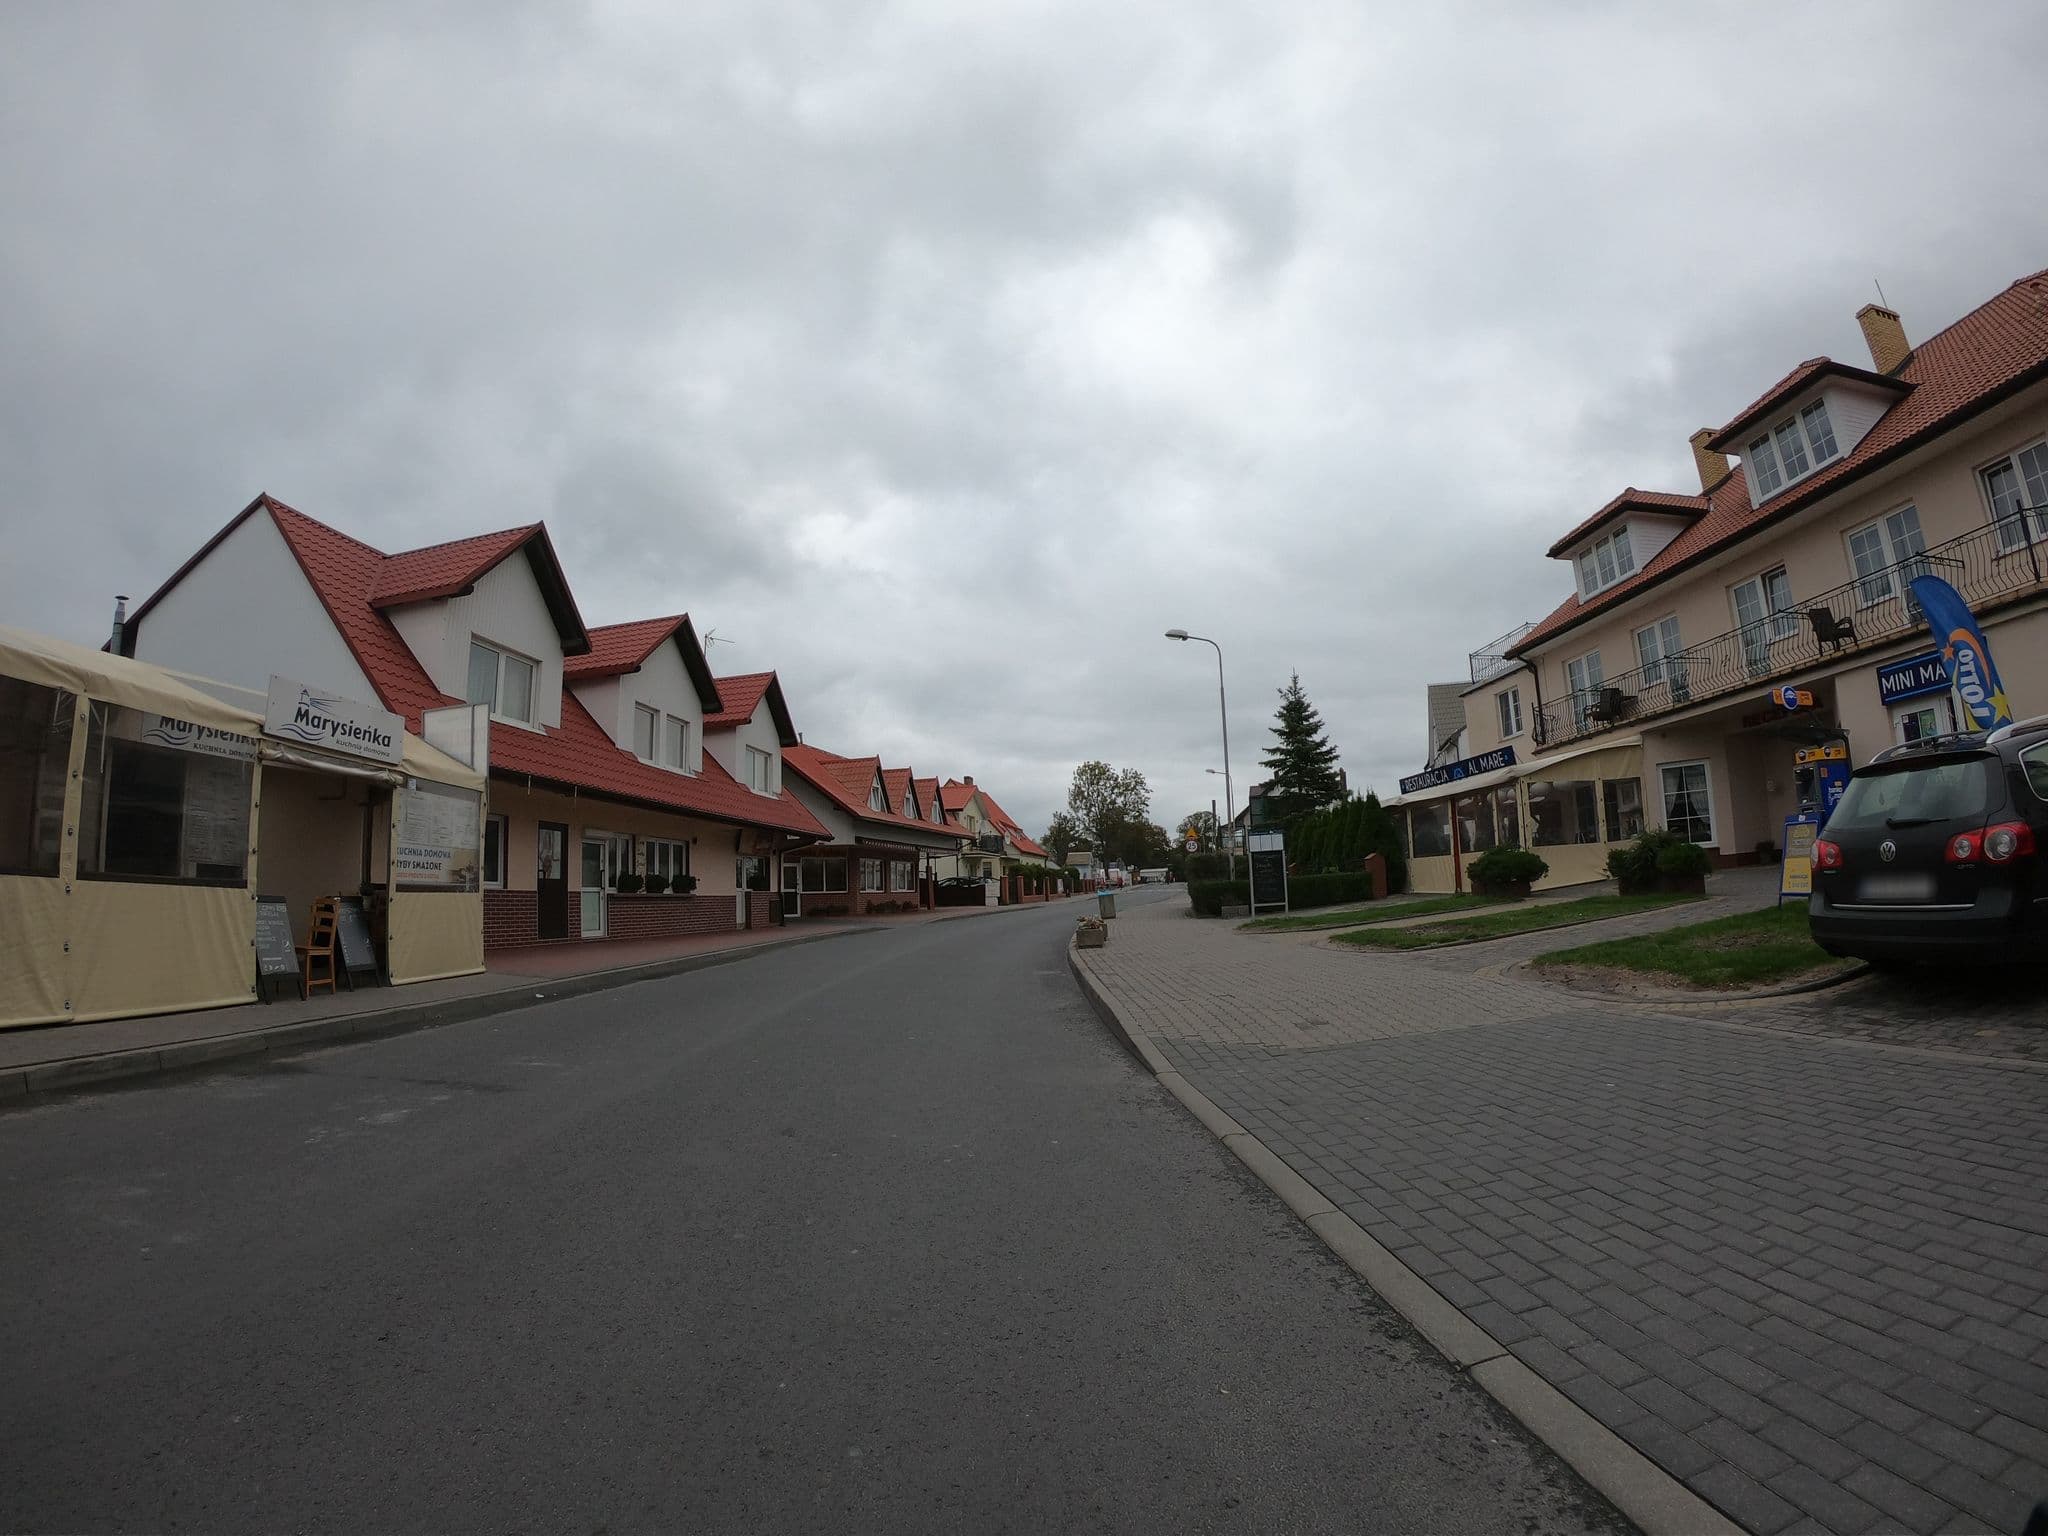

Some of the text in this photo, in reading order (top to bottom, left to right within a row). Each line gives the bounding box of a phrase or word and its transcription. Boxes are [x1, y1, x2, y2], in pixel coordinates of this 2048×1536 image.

[1881, 669, 1915, 694] MINI
[294, 706, 392, 747] Marysieńka
[193, 743, 227, 754] KUCHNIA
[336, 739, 362, 751] kuchnia
[1405, 752, 1505, 792] RESTAURACJA AL MARE
